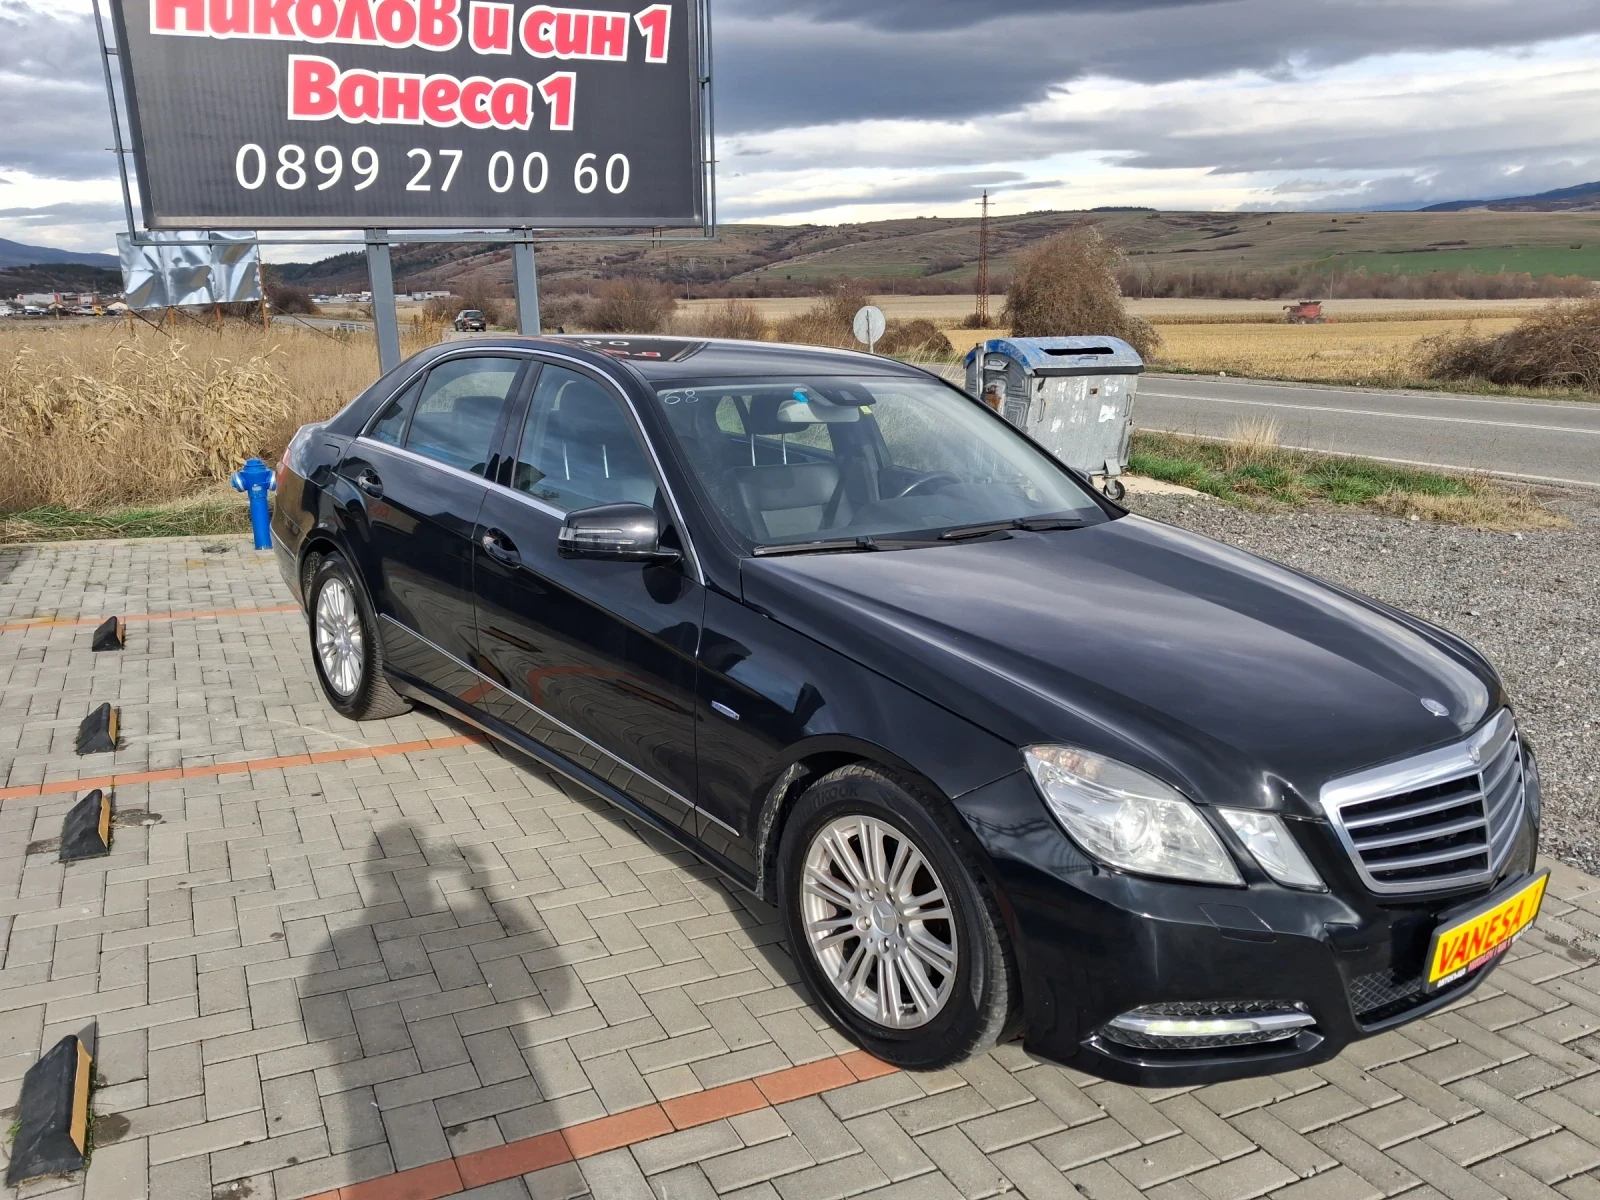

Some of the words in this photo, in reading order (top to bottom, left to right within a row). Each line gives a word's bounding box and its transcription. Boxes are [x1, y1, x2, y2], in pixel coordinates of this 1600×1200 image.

[469, 2, 511, 54] и
[520, 6, 629, 62] син
[634, 5, 671, 63] 1
[288, 55, 533, 130] Ванеса
[543, 72, 576, 130] 1
[235, 143, 379, 191] 0899
[406, 149, 462, 191] 27
[488, 152, 548, 193] 00
[574, 154, 630, 194] 60
[664, 390, 699, 404] 68
[1439, 899, 1525, 974] VANESA
